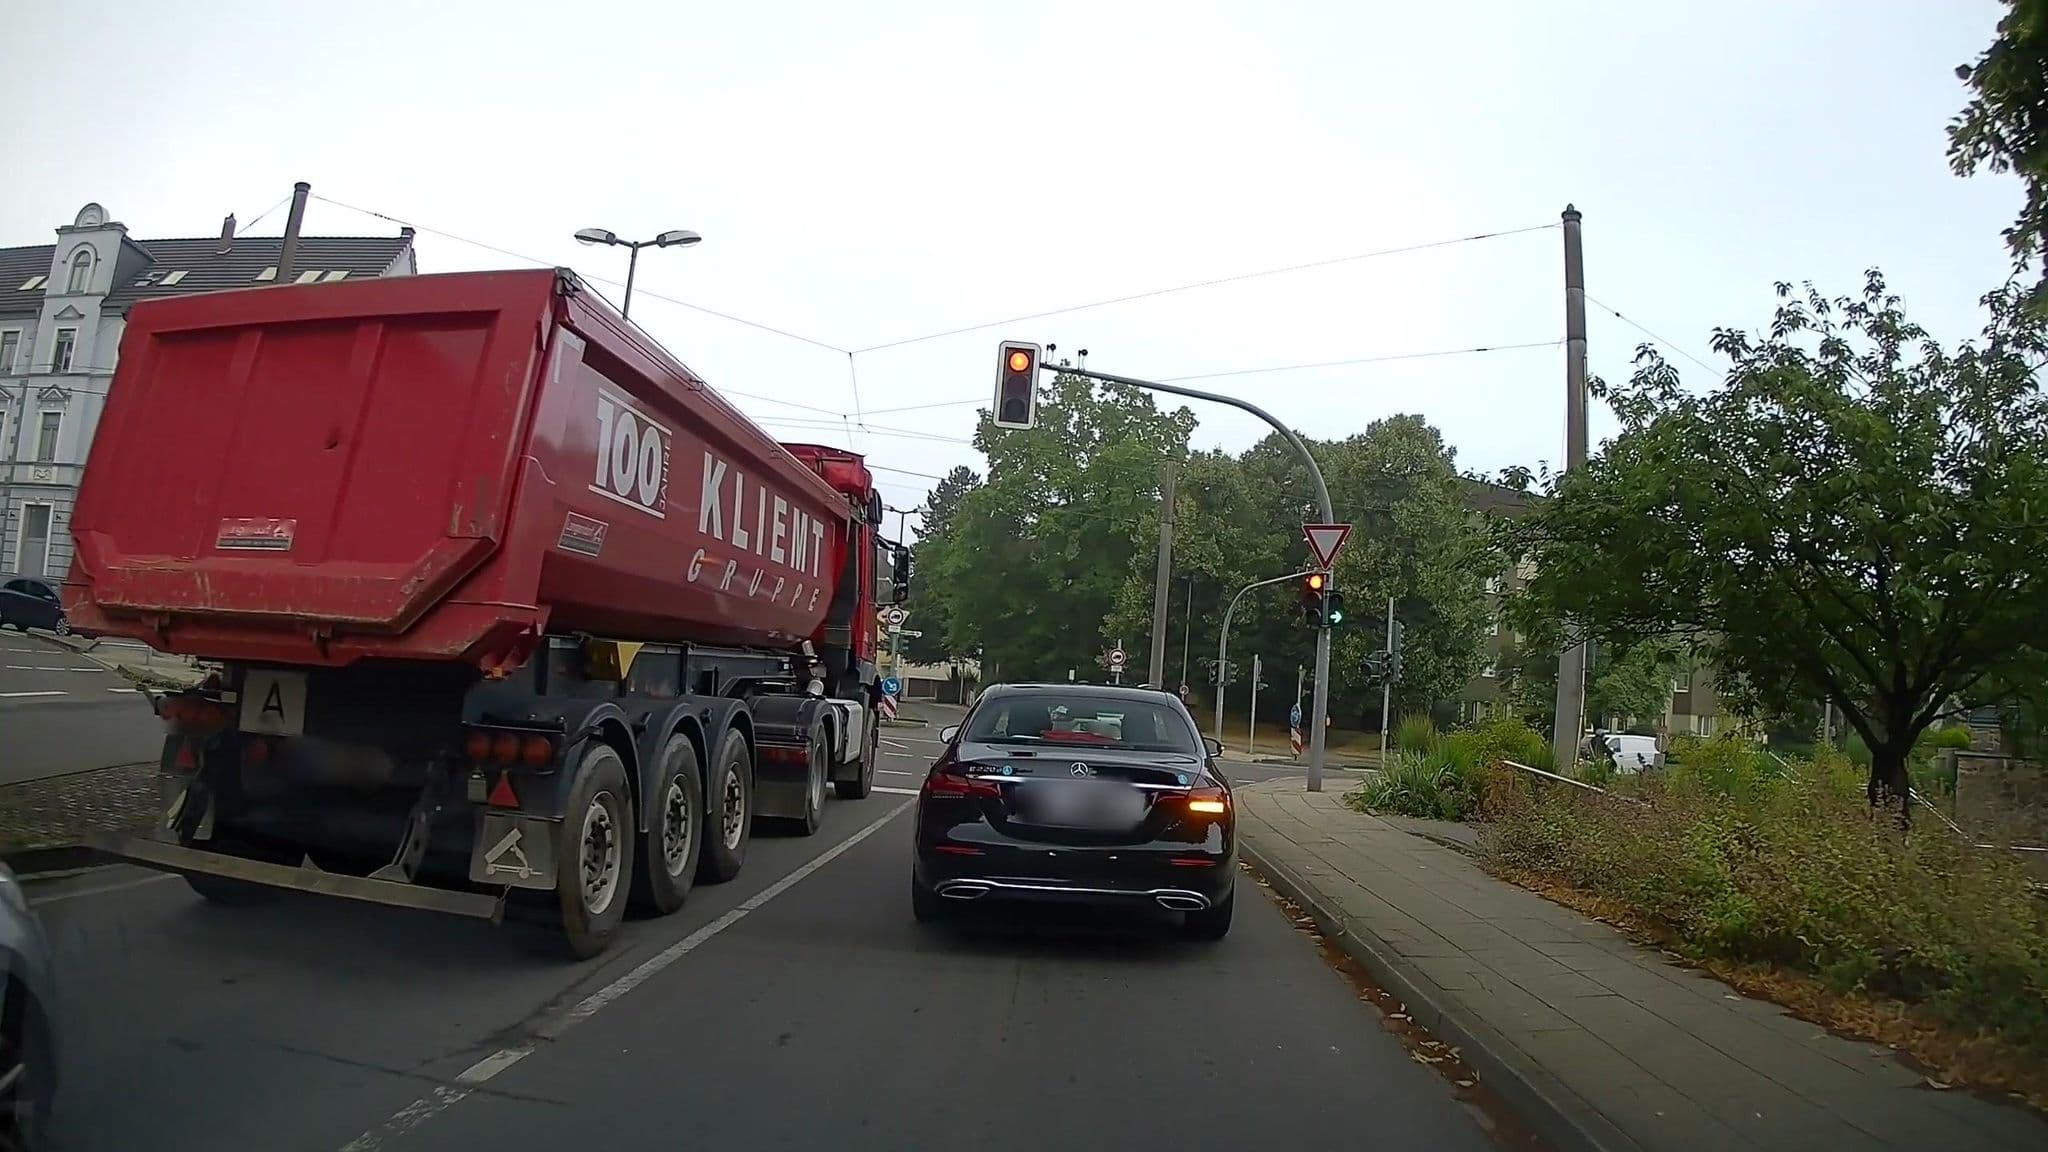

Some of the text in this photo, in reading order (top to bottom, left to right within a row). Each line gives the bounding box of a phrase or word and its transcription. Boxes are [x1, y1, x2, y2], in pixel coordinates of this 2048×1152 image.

[595, 397, 662, 507] 100
[659, 437, 672, 510] JAHRE
[698, 451, 825, 578] KLIEMT
[687, 548, 820, 612] GRUPPE
[262, 681, 285, 724] A
